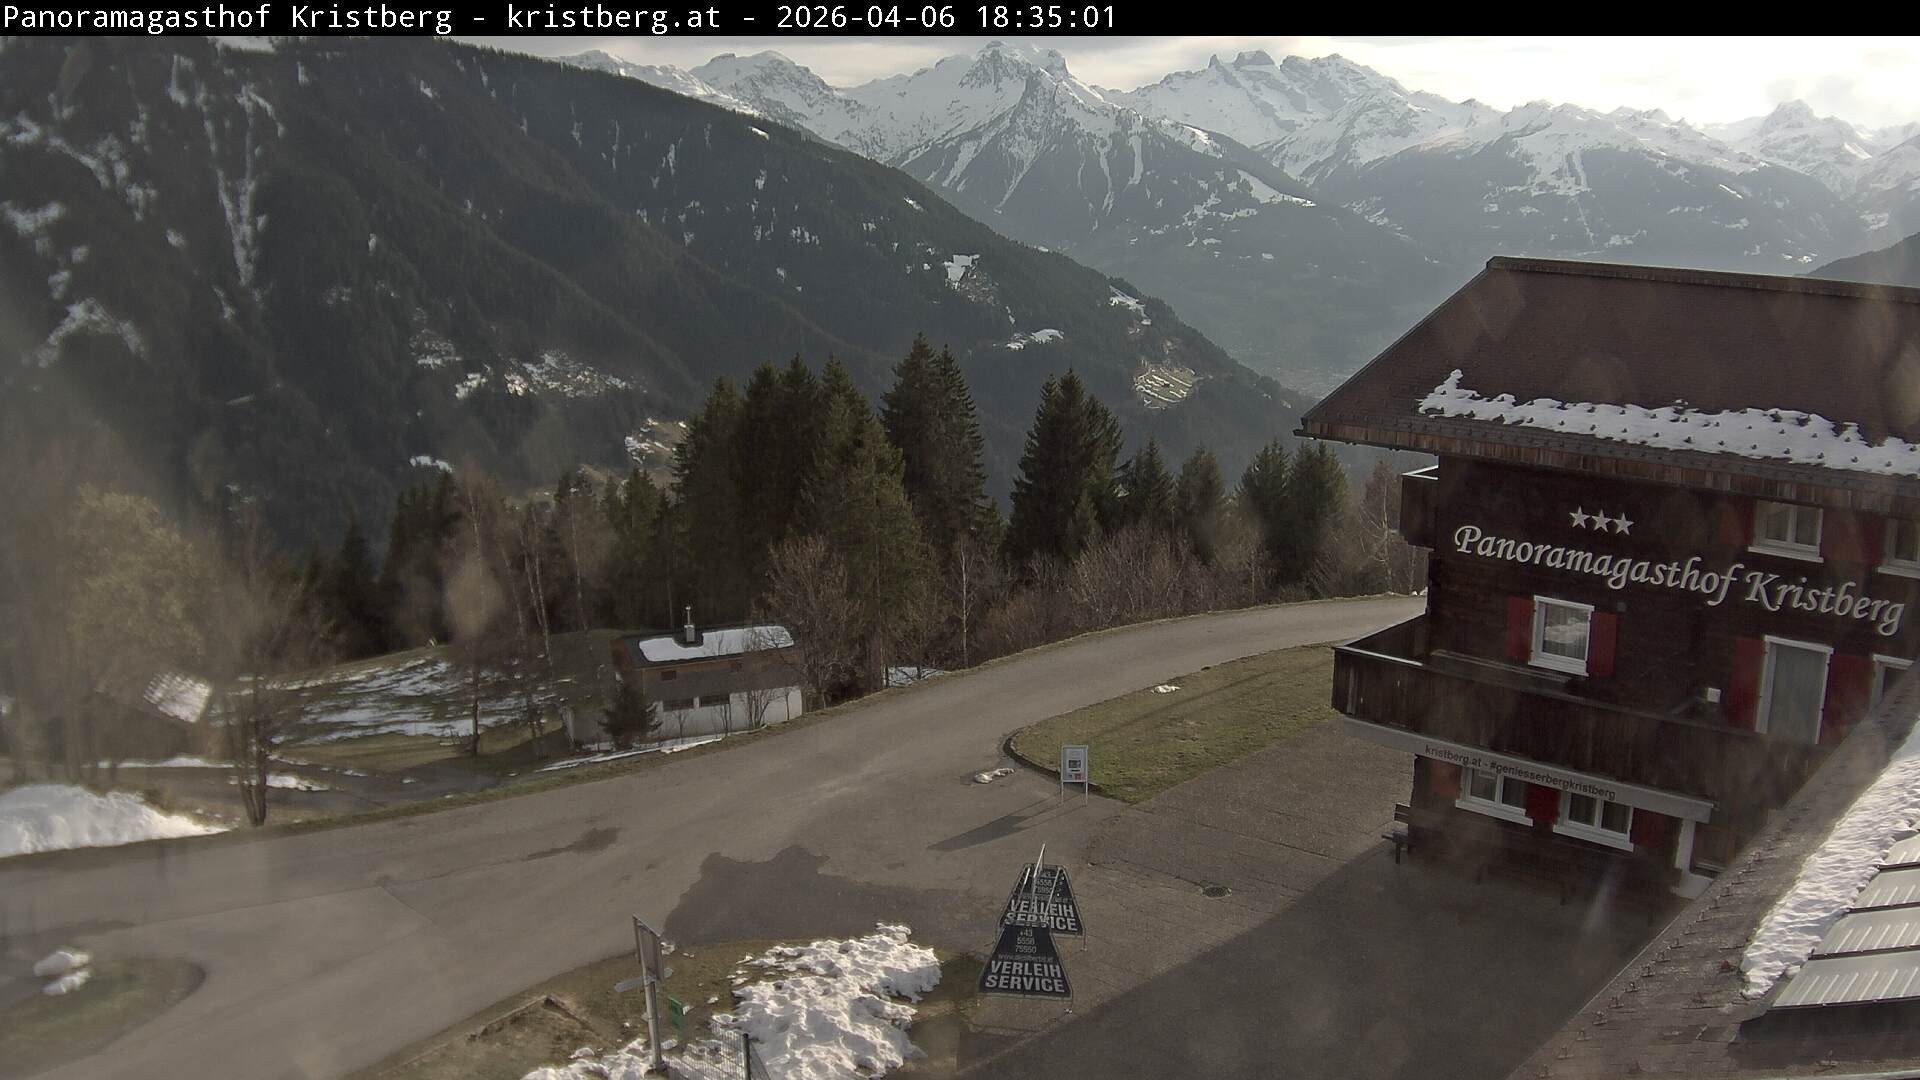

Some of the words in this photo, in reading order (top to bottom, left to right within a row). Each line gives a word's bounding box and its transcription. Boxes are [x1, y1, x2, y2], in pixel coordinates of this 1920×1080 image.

[1454, 525, 1745, 606] Panoramagasthof
[1745, 571, 1905, 636] Kristberg
[1425, 745, 1482, 767] kristberg.at
[991, 960, 1061, 978] VERLEIH
[985, 975, 1065, 993] SERVICE
